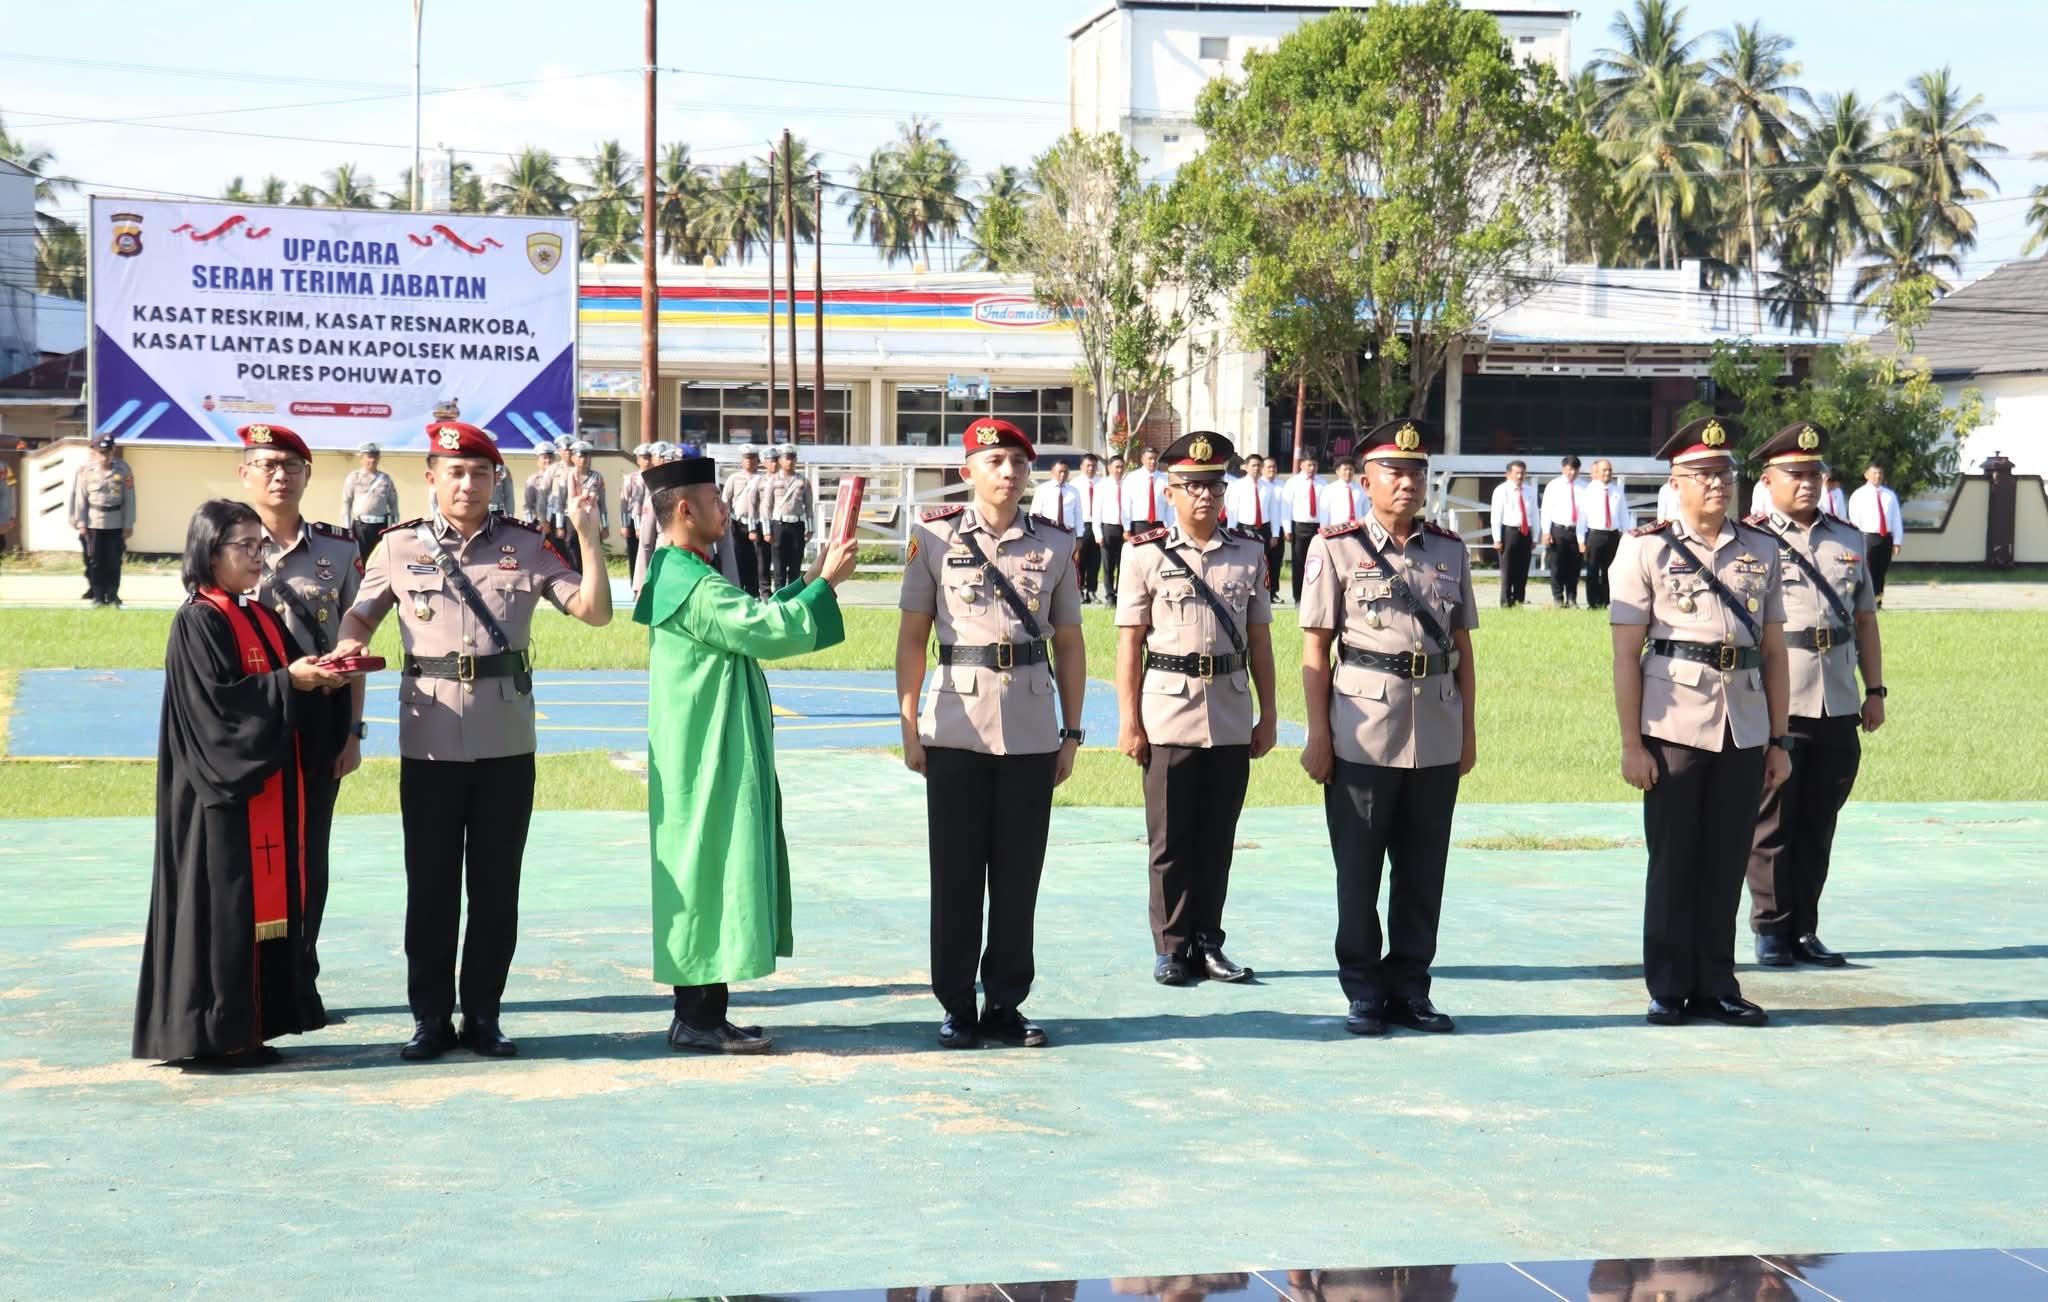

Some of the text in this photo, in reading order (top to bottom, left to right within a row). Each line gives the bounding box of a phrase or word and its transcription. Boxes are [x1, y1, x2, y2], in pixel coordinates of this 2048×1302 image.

[283, 237, 400, 266] UPACARA
[192, 264, 486, 300] SERAH TERIMA JABATAN
[133, 304, 536, 338] KASAT RESKRIM, KASAT RESNARKOBA,
[133, 332, 540, 363] KASAT LANTAS DAN KAPOLSEK MARISA
[237, 362, 442, 386] POLRES POHUWATO
